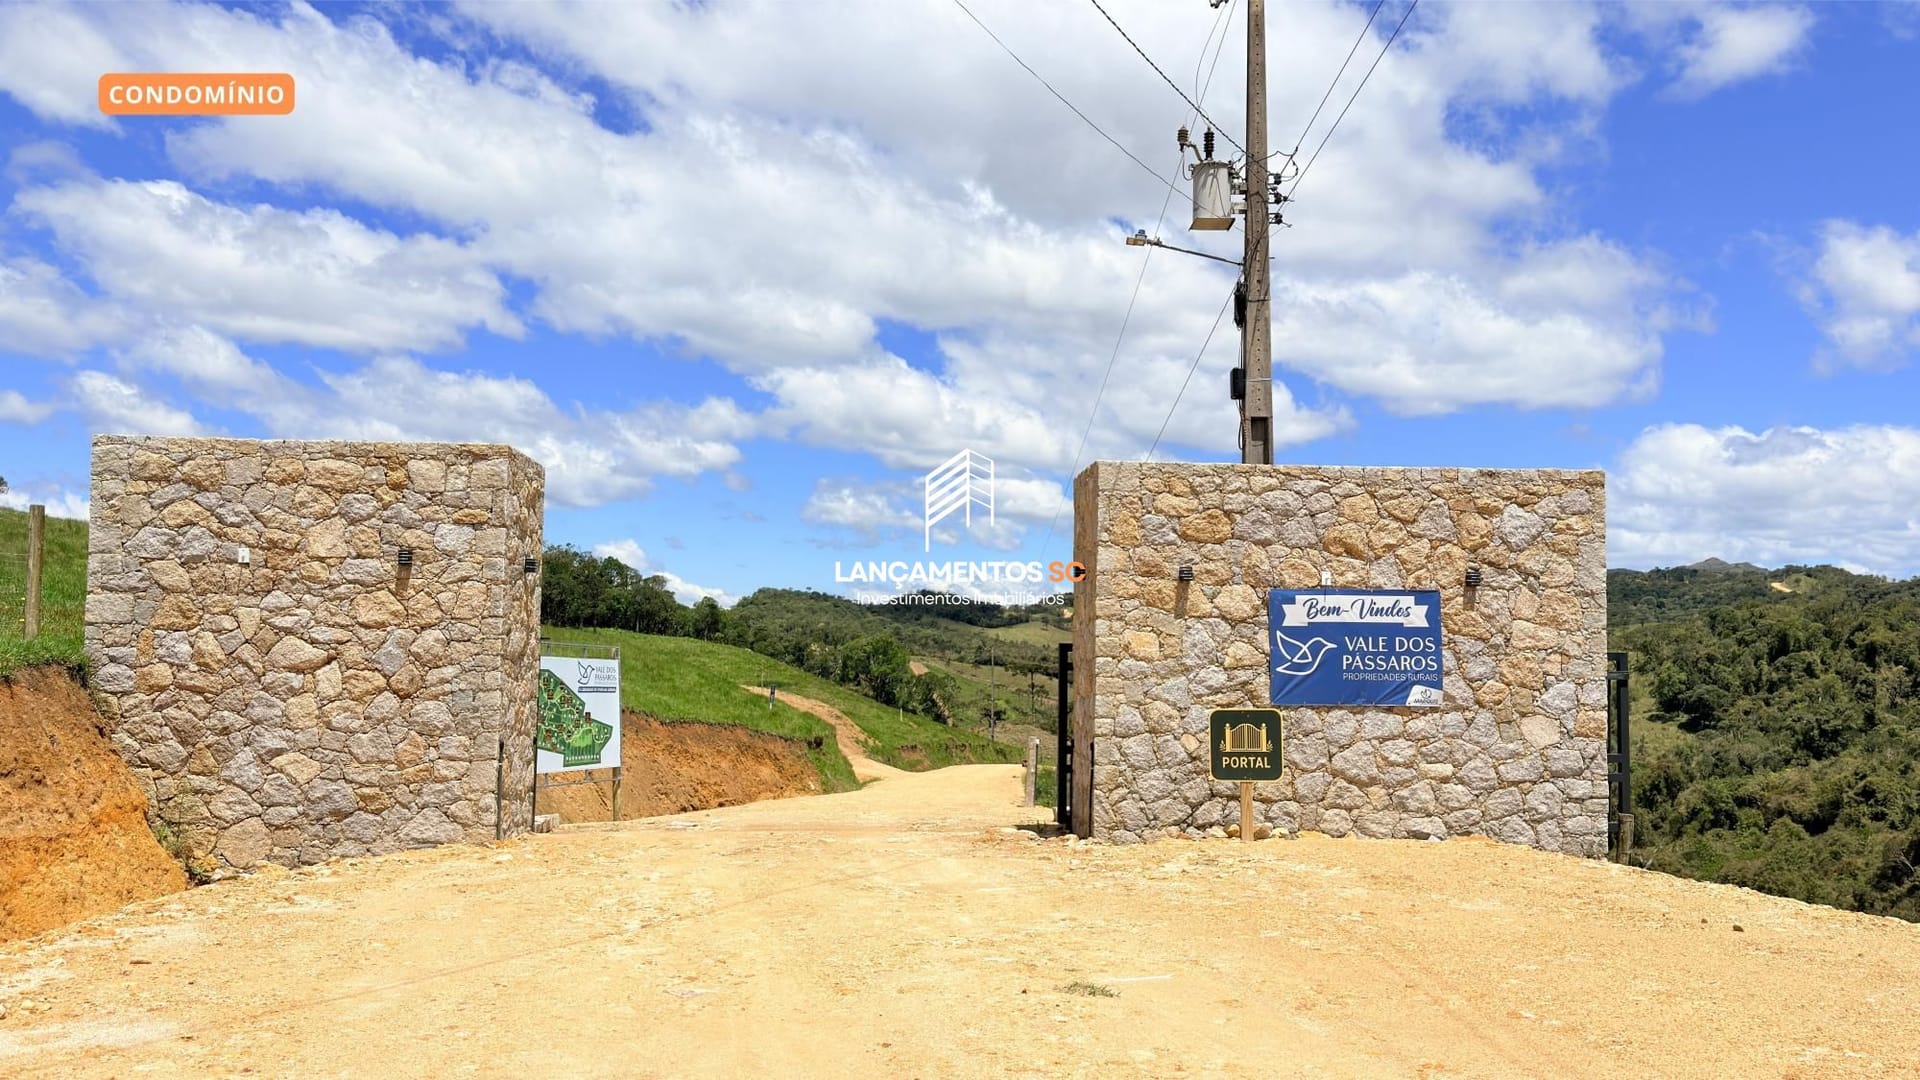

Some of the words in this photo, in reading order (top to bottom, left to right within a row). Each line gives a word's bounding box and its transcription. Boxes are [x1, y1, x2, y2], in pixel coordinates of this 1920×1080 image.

[1344, 636, 1388, 652] VALE
[1395, 636, 1436, 652] DOS
[1342, 652, 1438, 671] PÁSSAROS
[1342, 672, 1407, 681] PROPRIEDADES
[1408, 673, 1438, 682] RURAIS
[1222, 756, 1271, 769] PORTAL
